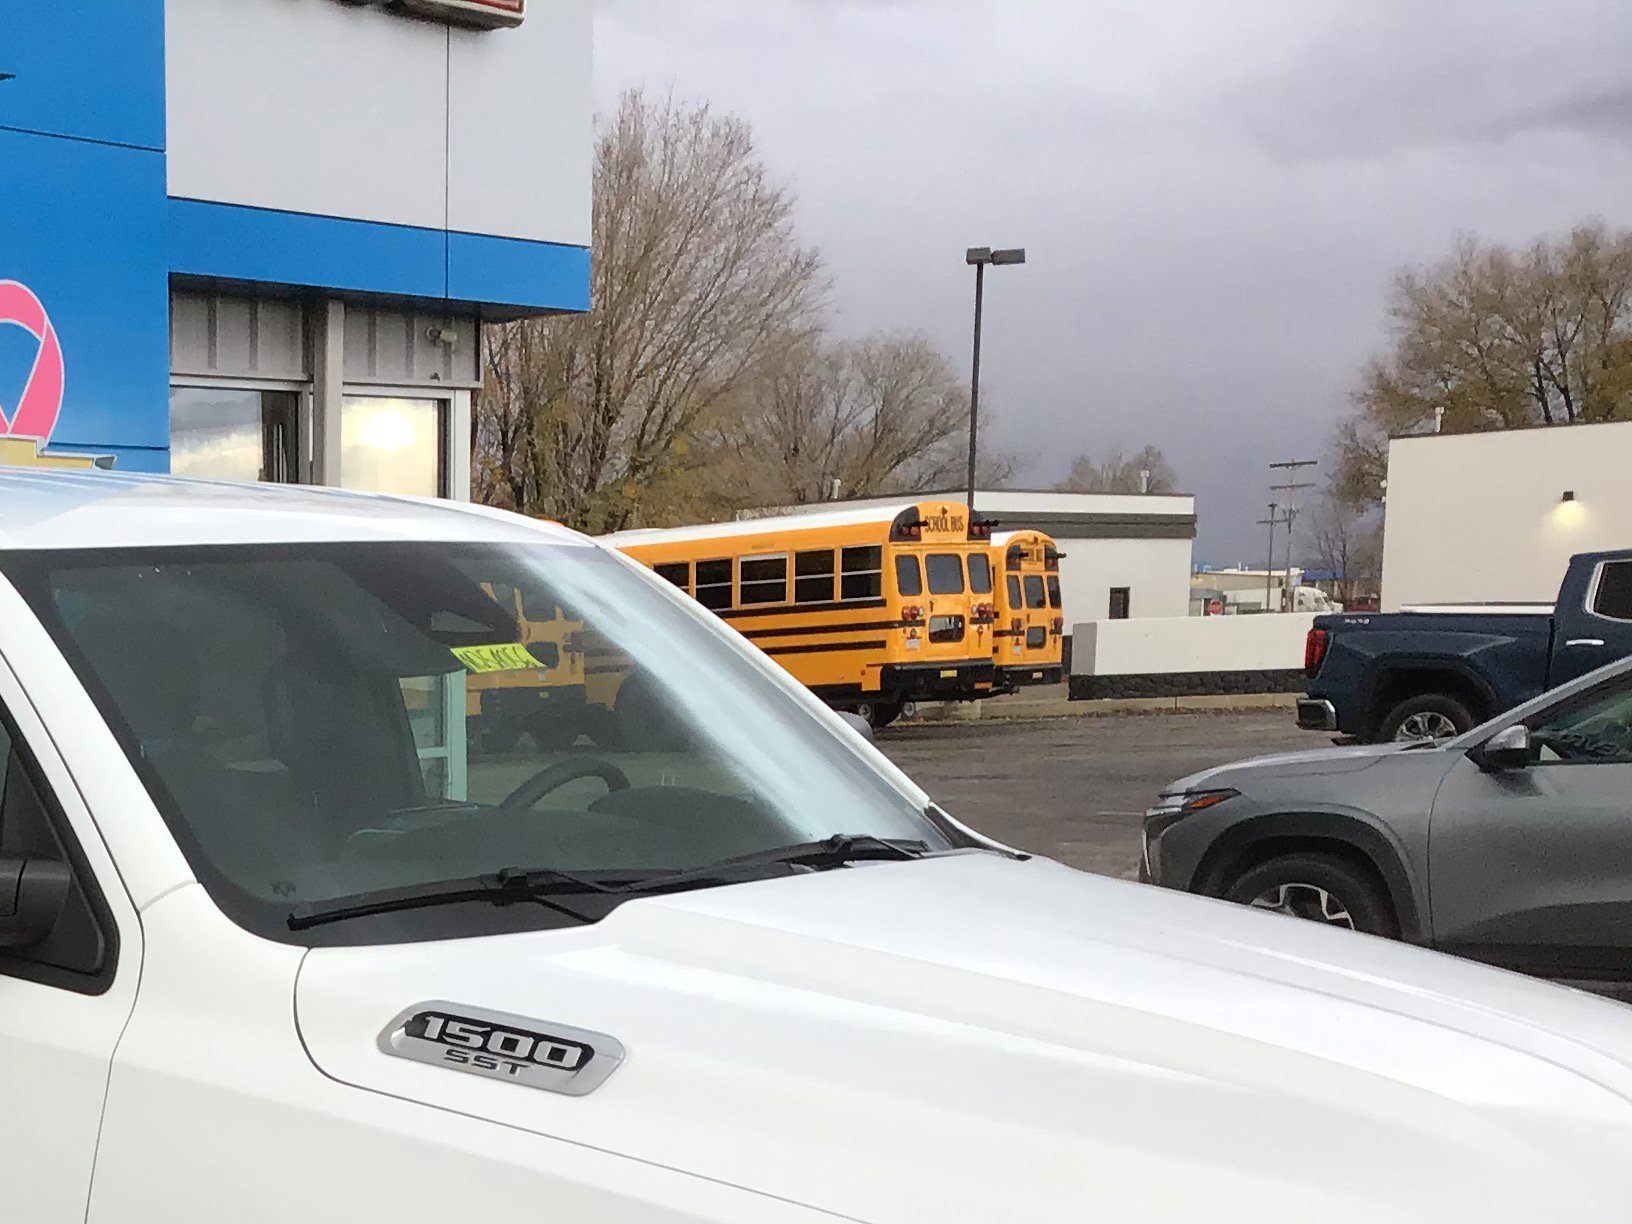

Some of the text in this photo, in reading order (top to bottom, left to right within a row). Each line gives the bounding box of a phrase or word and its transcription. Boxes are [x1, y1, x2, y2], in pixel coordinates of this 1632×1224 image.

[925, 515, 964, 532] SCHOOL BUS
[422, 1015, 583, 1069] 1500
[443, 1048, 531, 1077] SST
